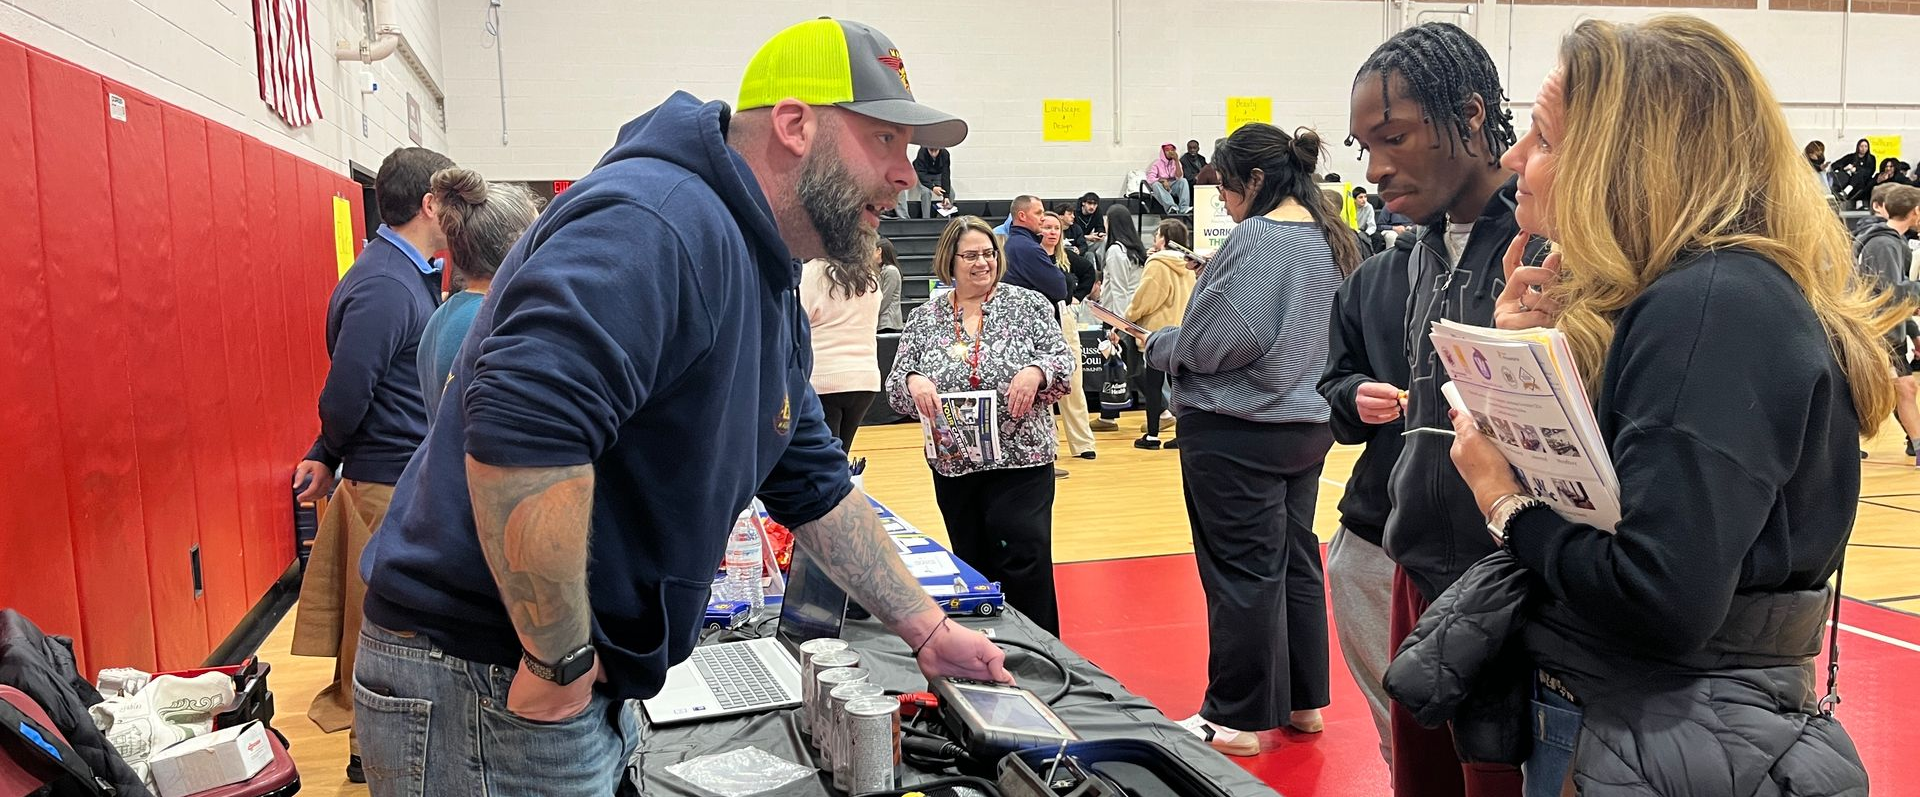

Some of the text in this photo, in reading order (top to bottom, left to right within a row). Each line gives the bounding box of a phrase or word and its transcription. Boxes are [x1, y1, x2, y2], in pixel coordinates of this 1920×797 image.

[1044, 101, 1081, 117] Landscape
[942, 402, 955, 426] YOUR
[951, 426, 969, 458] CAREER
